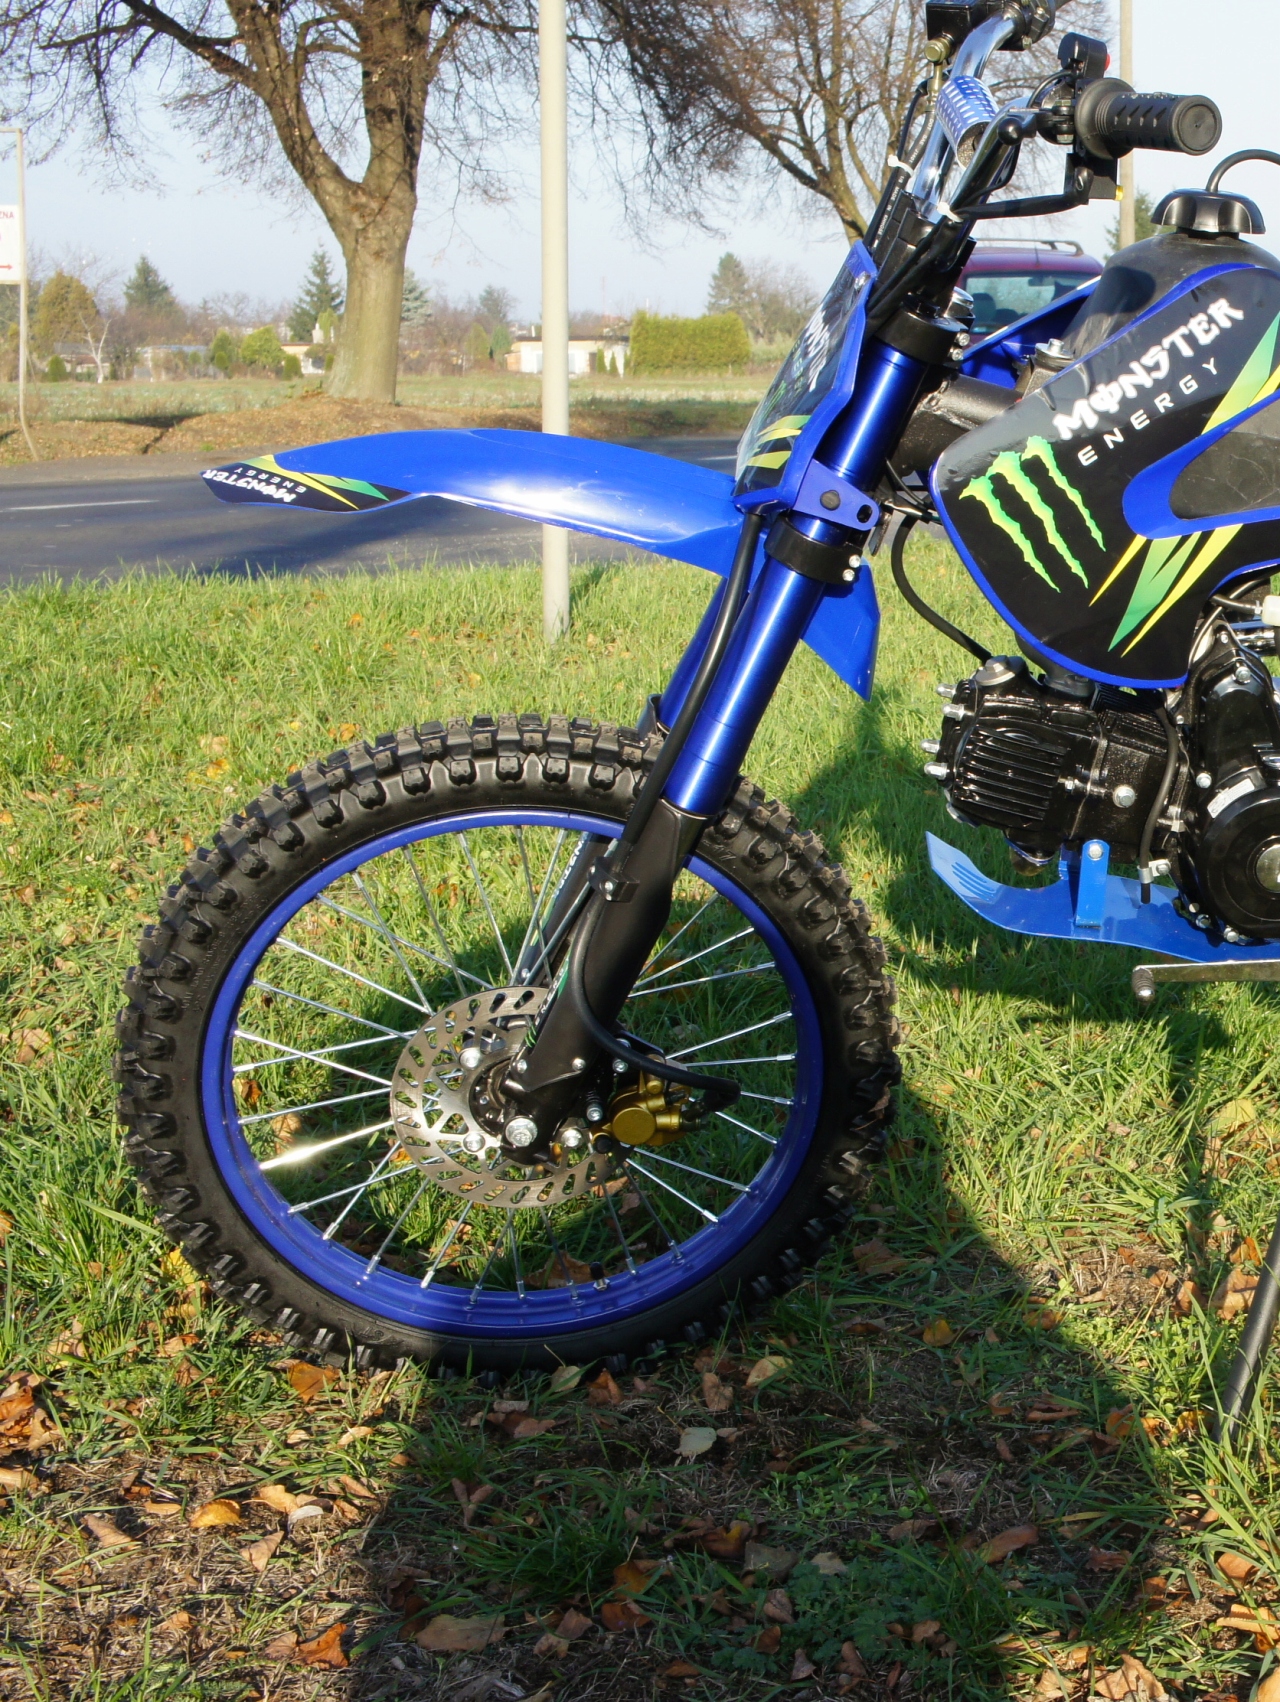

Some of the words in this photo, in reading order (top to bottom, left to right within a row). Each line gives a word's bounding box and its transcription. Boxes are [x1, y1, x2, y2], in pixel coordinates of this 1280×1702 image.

[1053, 298, 1244, 440] MONSTER
[1077, 357, 1217, 467] ENERGY
[234, 467, 307, 494] ENERGY
